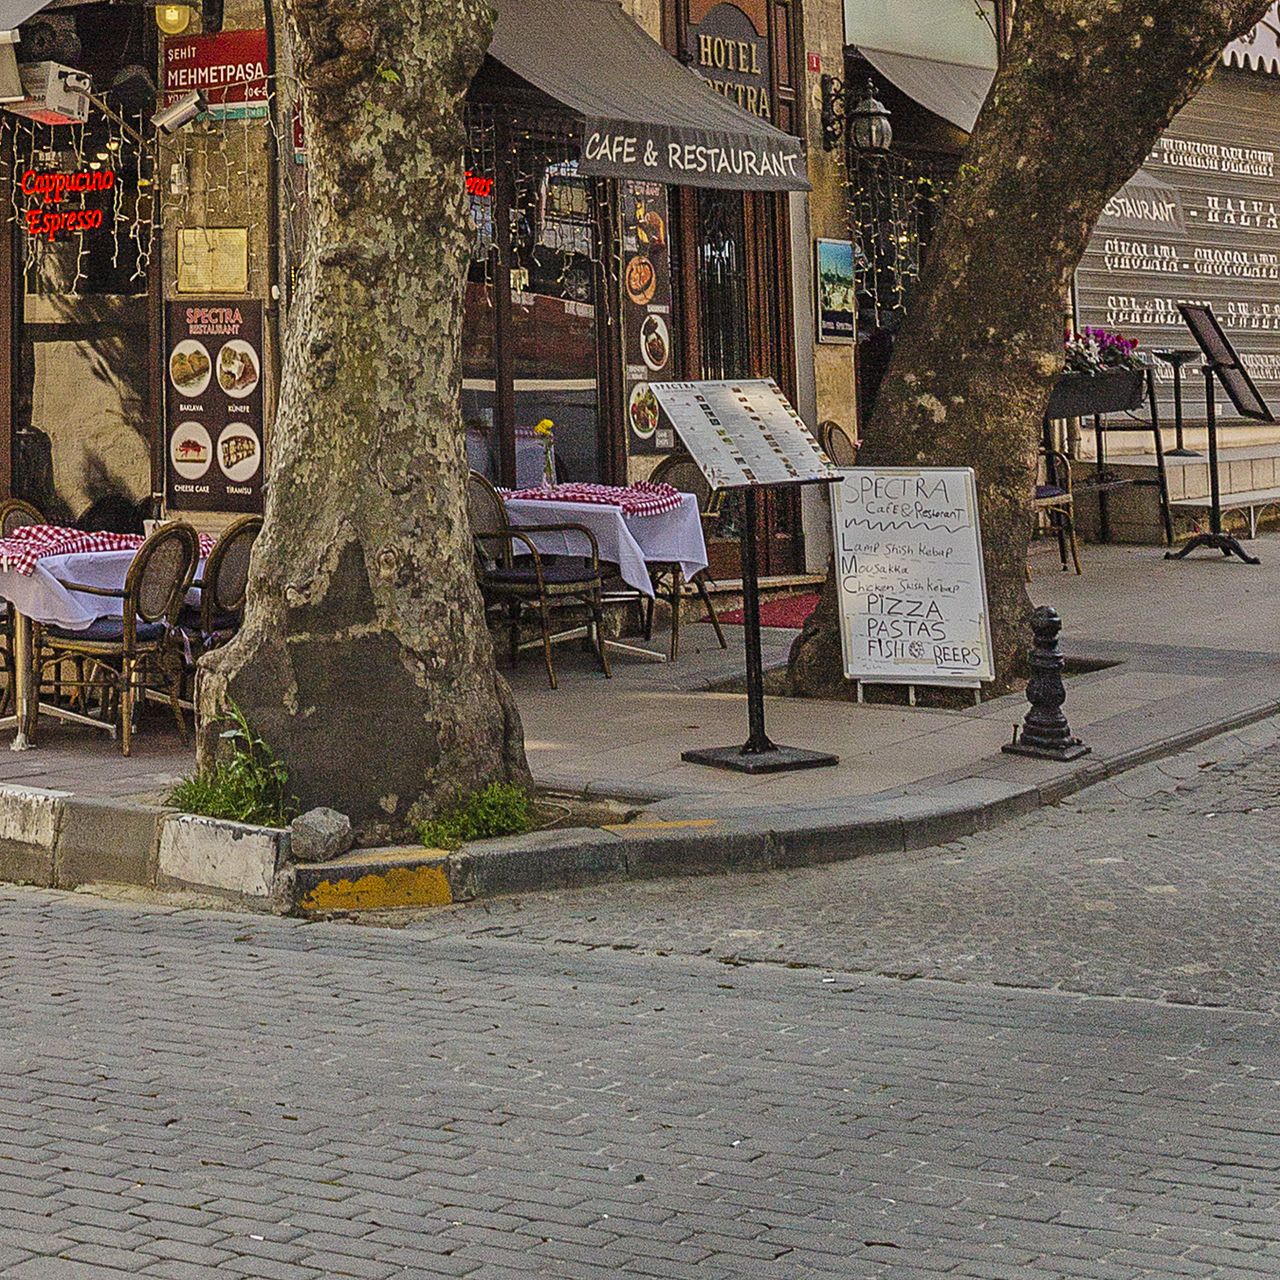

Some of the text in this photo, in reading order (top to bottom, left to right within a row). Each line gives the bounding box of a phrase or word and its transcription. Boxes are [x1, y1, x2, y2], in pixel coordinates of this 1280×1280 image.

[167, 45, 197, 61] ŞEHİT
[698, 33, 762, 75] HOTEL
[585, 132, 798, 177] CAFE & RESTAURANT
[21, 168, 115, 204] Cappucino
[26, 209, 103, 242] Espresso
[186, 307, 243, 324] SPECTRA
[189, 324, 240, 335] RESTAURANT
[844, 476, 949, 504] SPECTRA
[842, 575, 895, 594] Chicken
[867, 617, 947, 641] PASTAS
[867, 639, 982, 667] FISH BEERS
